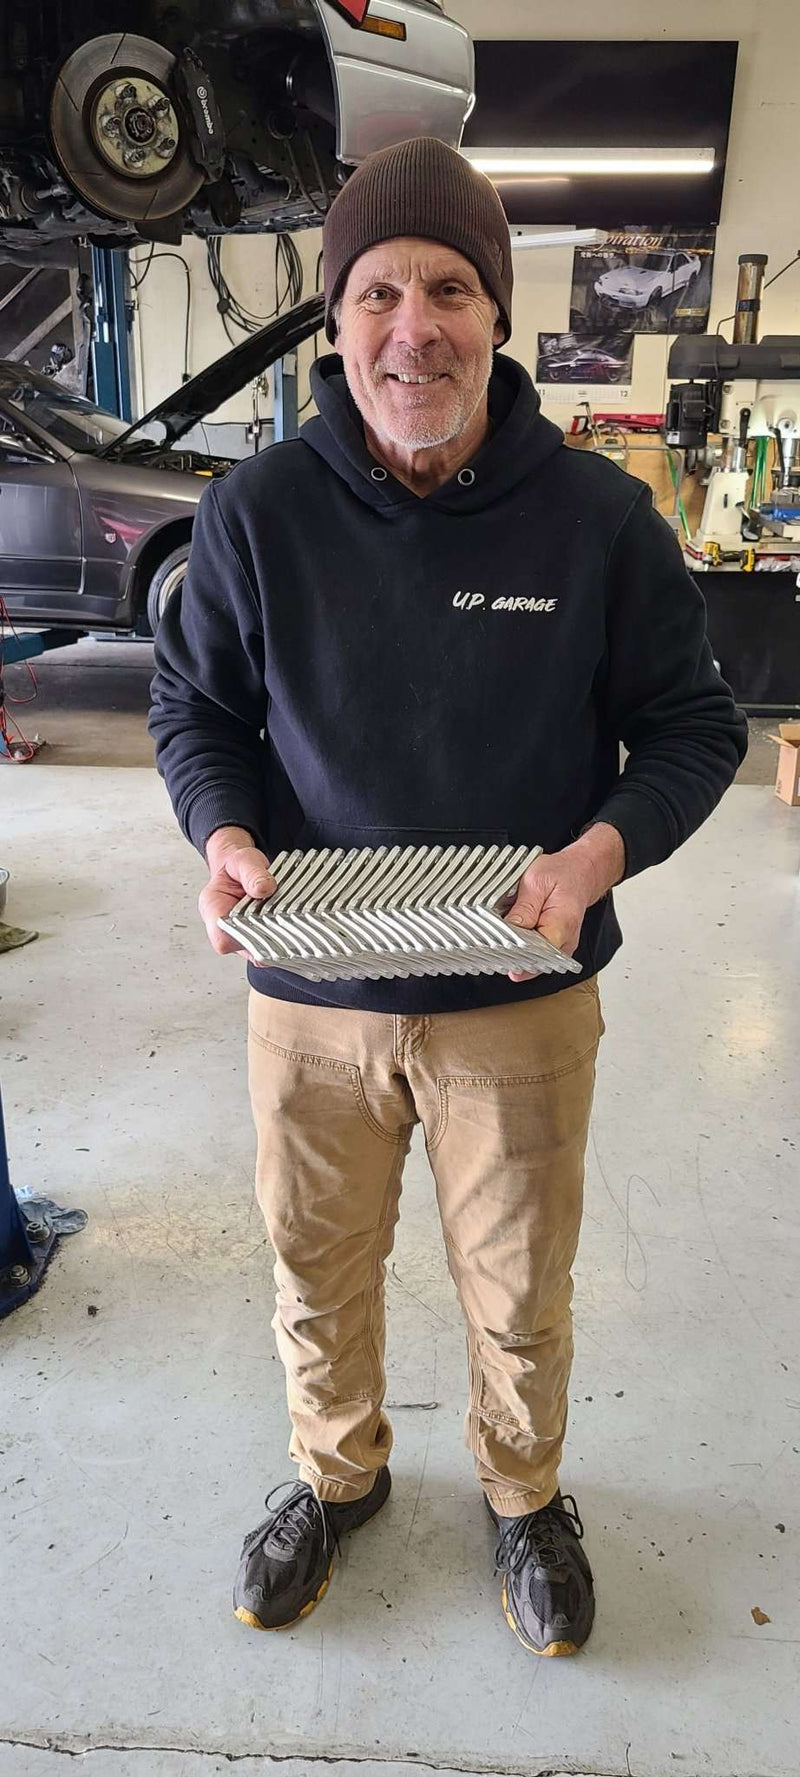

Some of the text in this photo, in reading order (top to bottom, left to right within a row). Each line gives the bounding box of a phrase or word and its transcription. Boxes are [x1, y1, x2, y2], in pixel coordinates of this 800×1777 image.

[201, 99, 214, 135] brembo
[593, 231, 664, 252] piration
[491, 597, 558, 612] GARAGE
